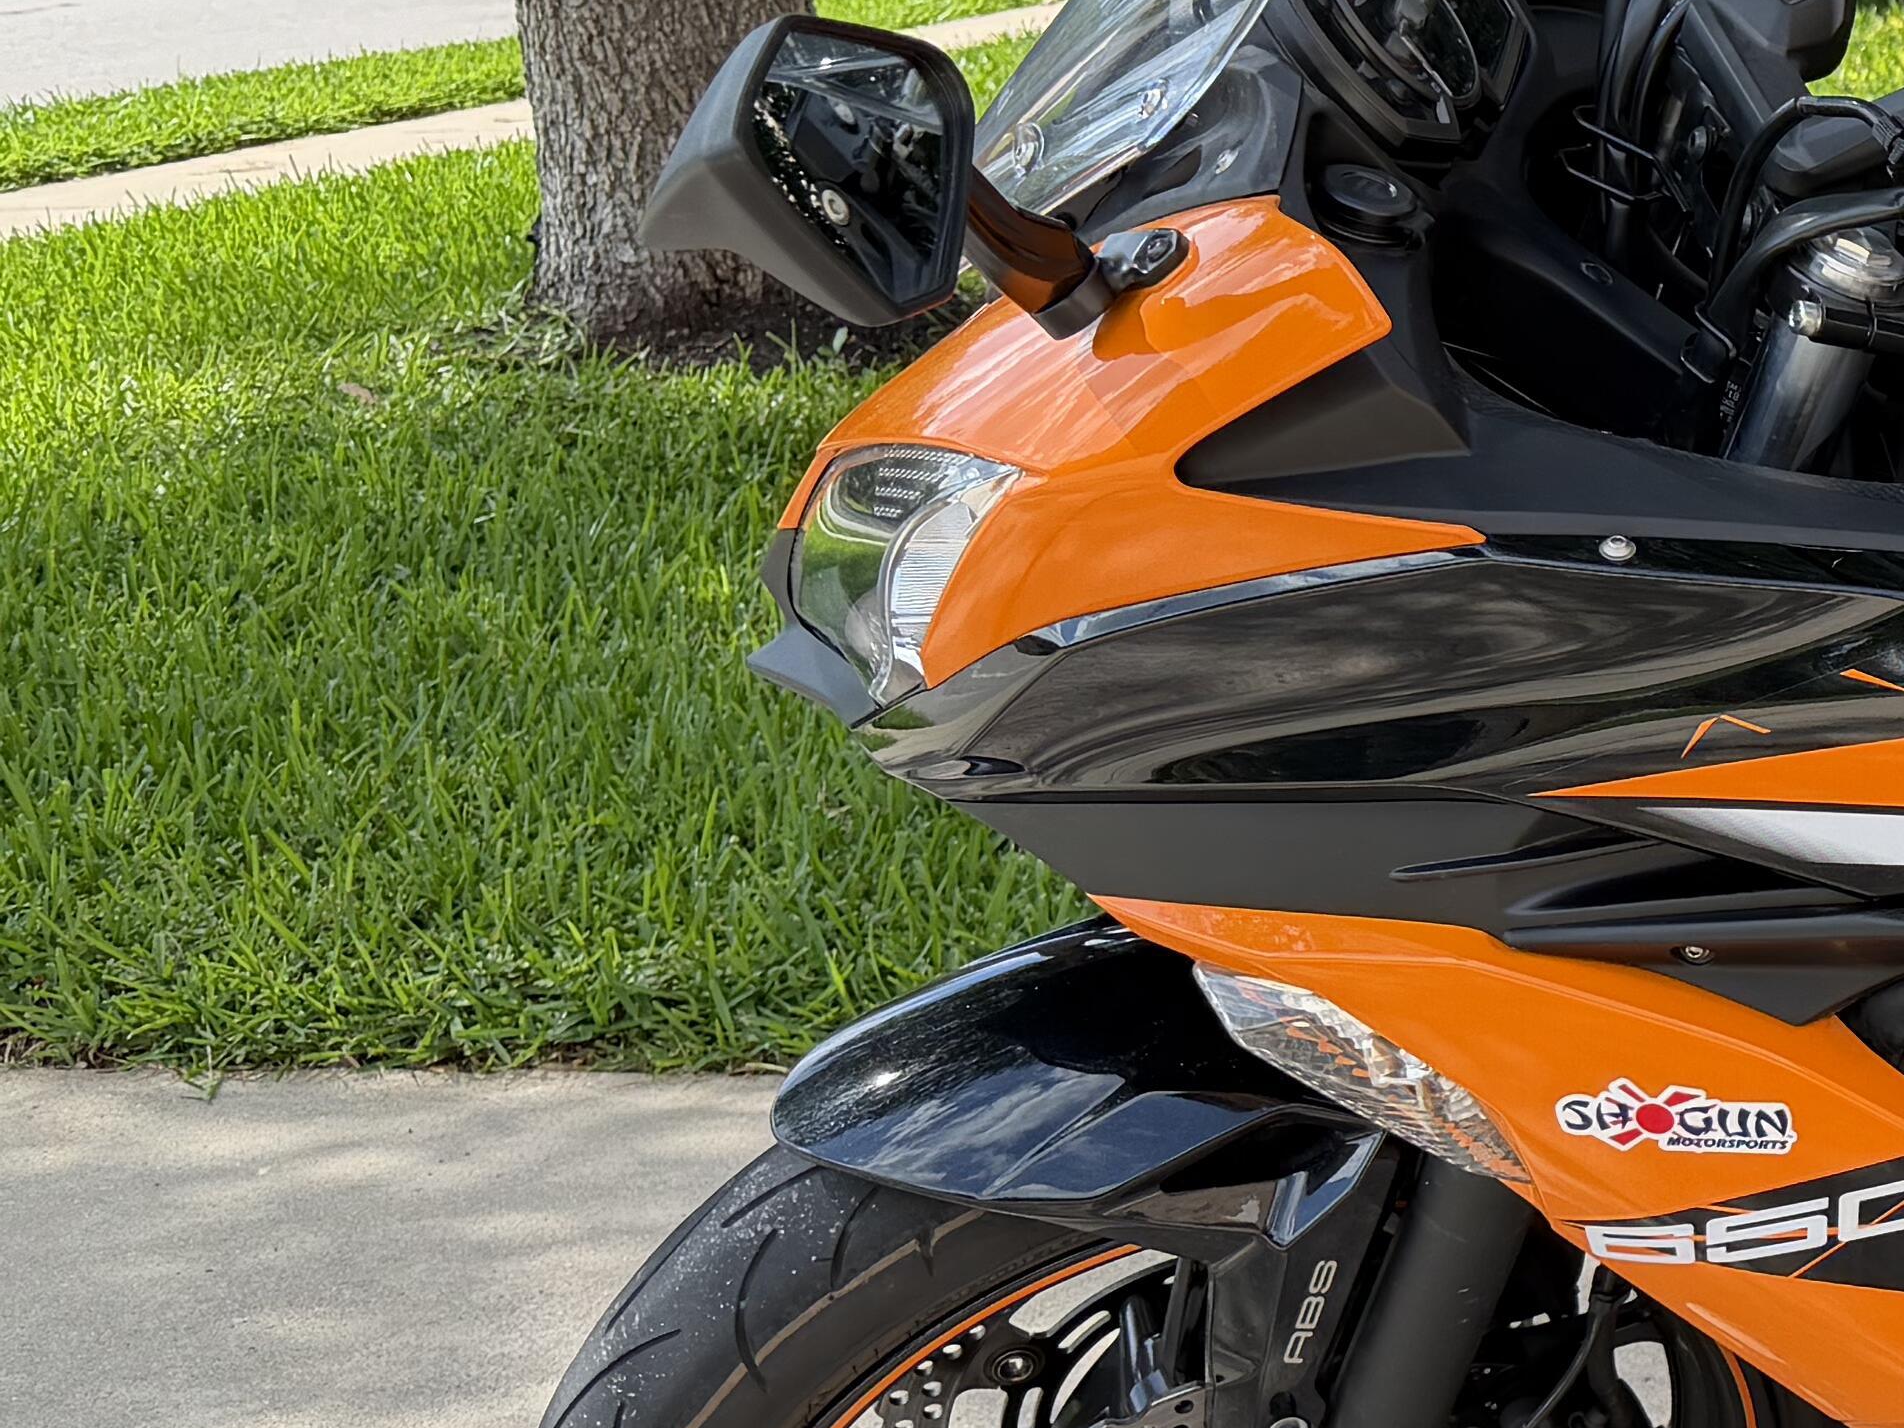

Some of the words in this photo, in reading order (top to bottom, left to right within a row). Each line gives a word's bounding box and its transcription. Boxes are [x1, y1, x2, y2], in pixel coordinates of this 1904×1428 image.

[1562, 1097, 1789, 1138] SHOGUN
[1666, 1136, 1789, 1150] MOTORSPORTS
[1283, 1259, 1338, 1365] ABS
